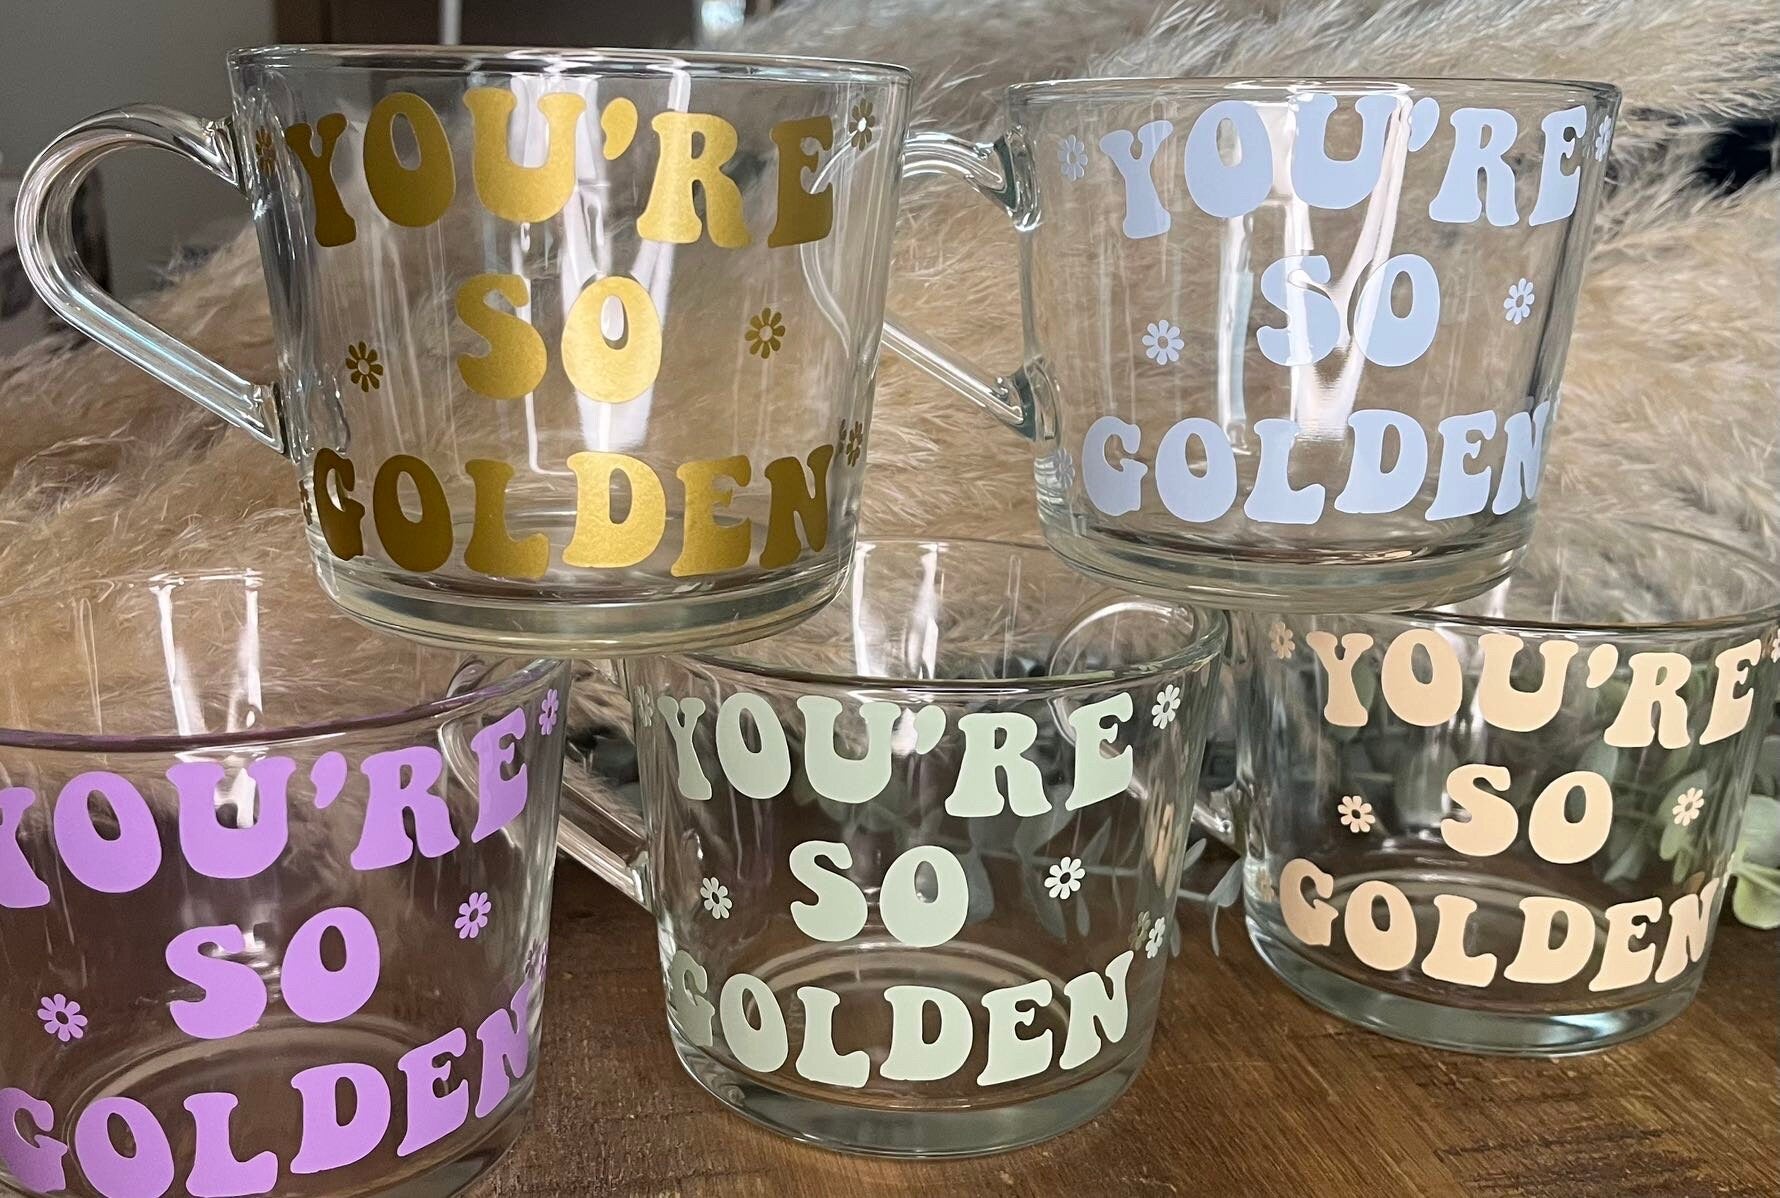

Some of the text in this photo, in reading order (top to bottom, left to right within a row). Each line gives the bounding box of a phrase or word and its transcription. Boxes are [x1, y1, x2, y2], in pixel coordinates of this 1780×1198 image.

[284, 88, 834, 248] YOU'RE
[1100, 95, 1587, 239] YOU'RE
[456, 274, 662, 403] SO
[1257, 253, 1440, 366] SO
[313, 444, 834, 580] GOLDEN
[1081, 402, 1550, 525] GOLDEN
[1306, 629, 1762, 749] YOU'RE
[657, 692, 1134, 818] YOU'RE
[1441, 764, 1613, 864] SO
[789, 840, 969, 947] SO
[1279, 878, 1719, 992] GOLDEN
[165, 906, 381, 1039] SO
[670, 950, 1134, 1087] GOLDEN
[0, 980, 532, 1198] GOLDEN
